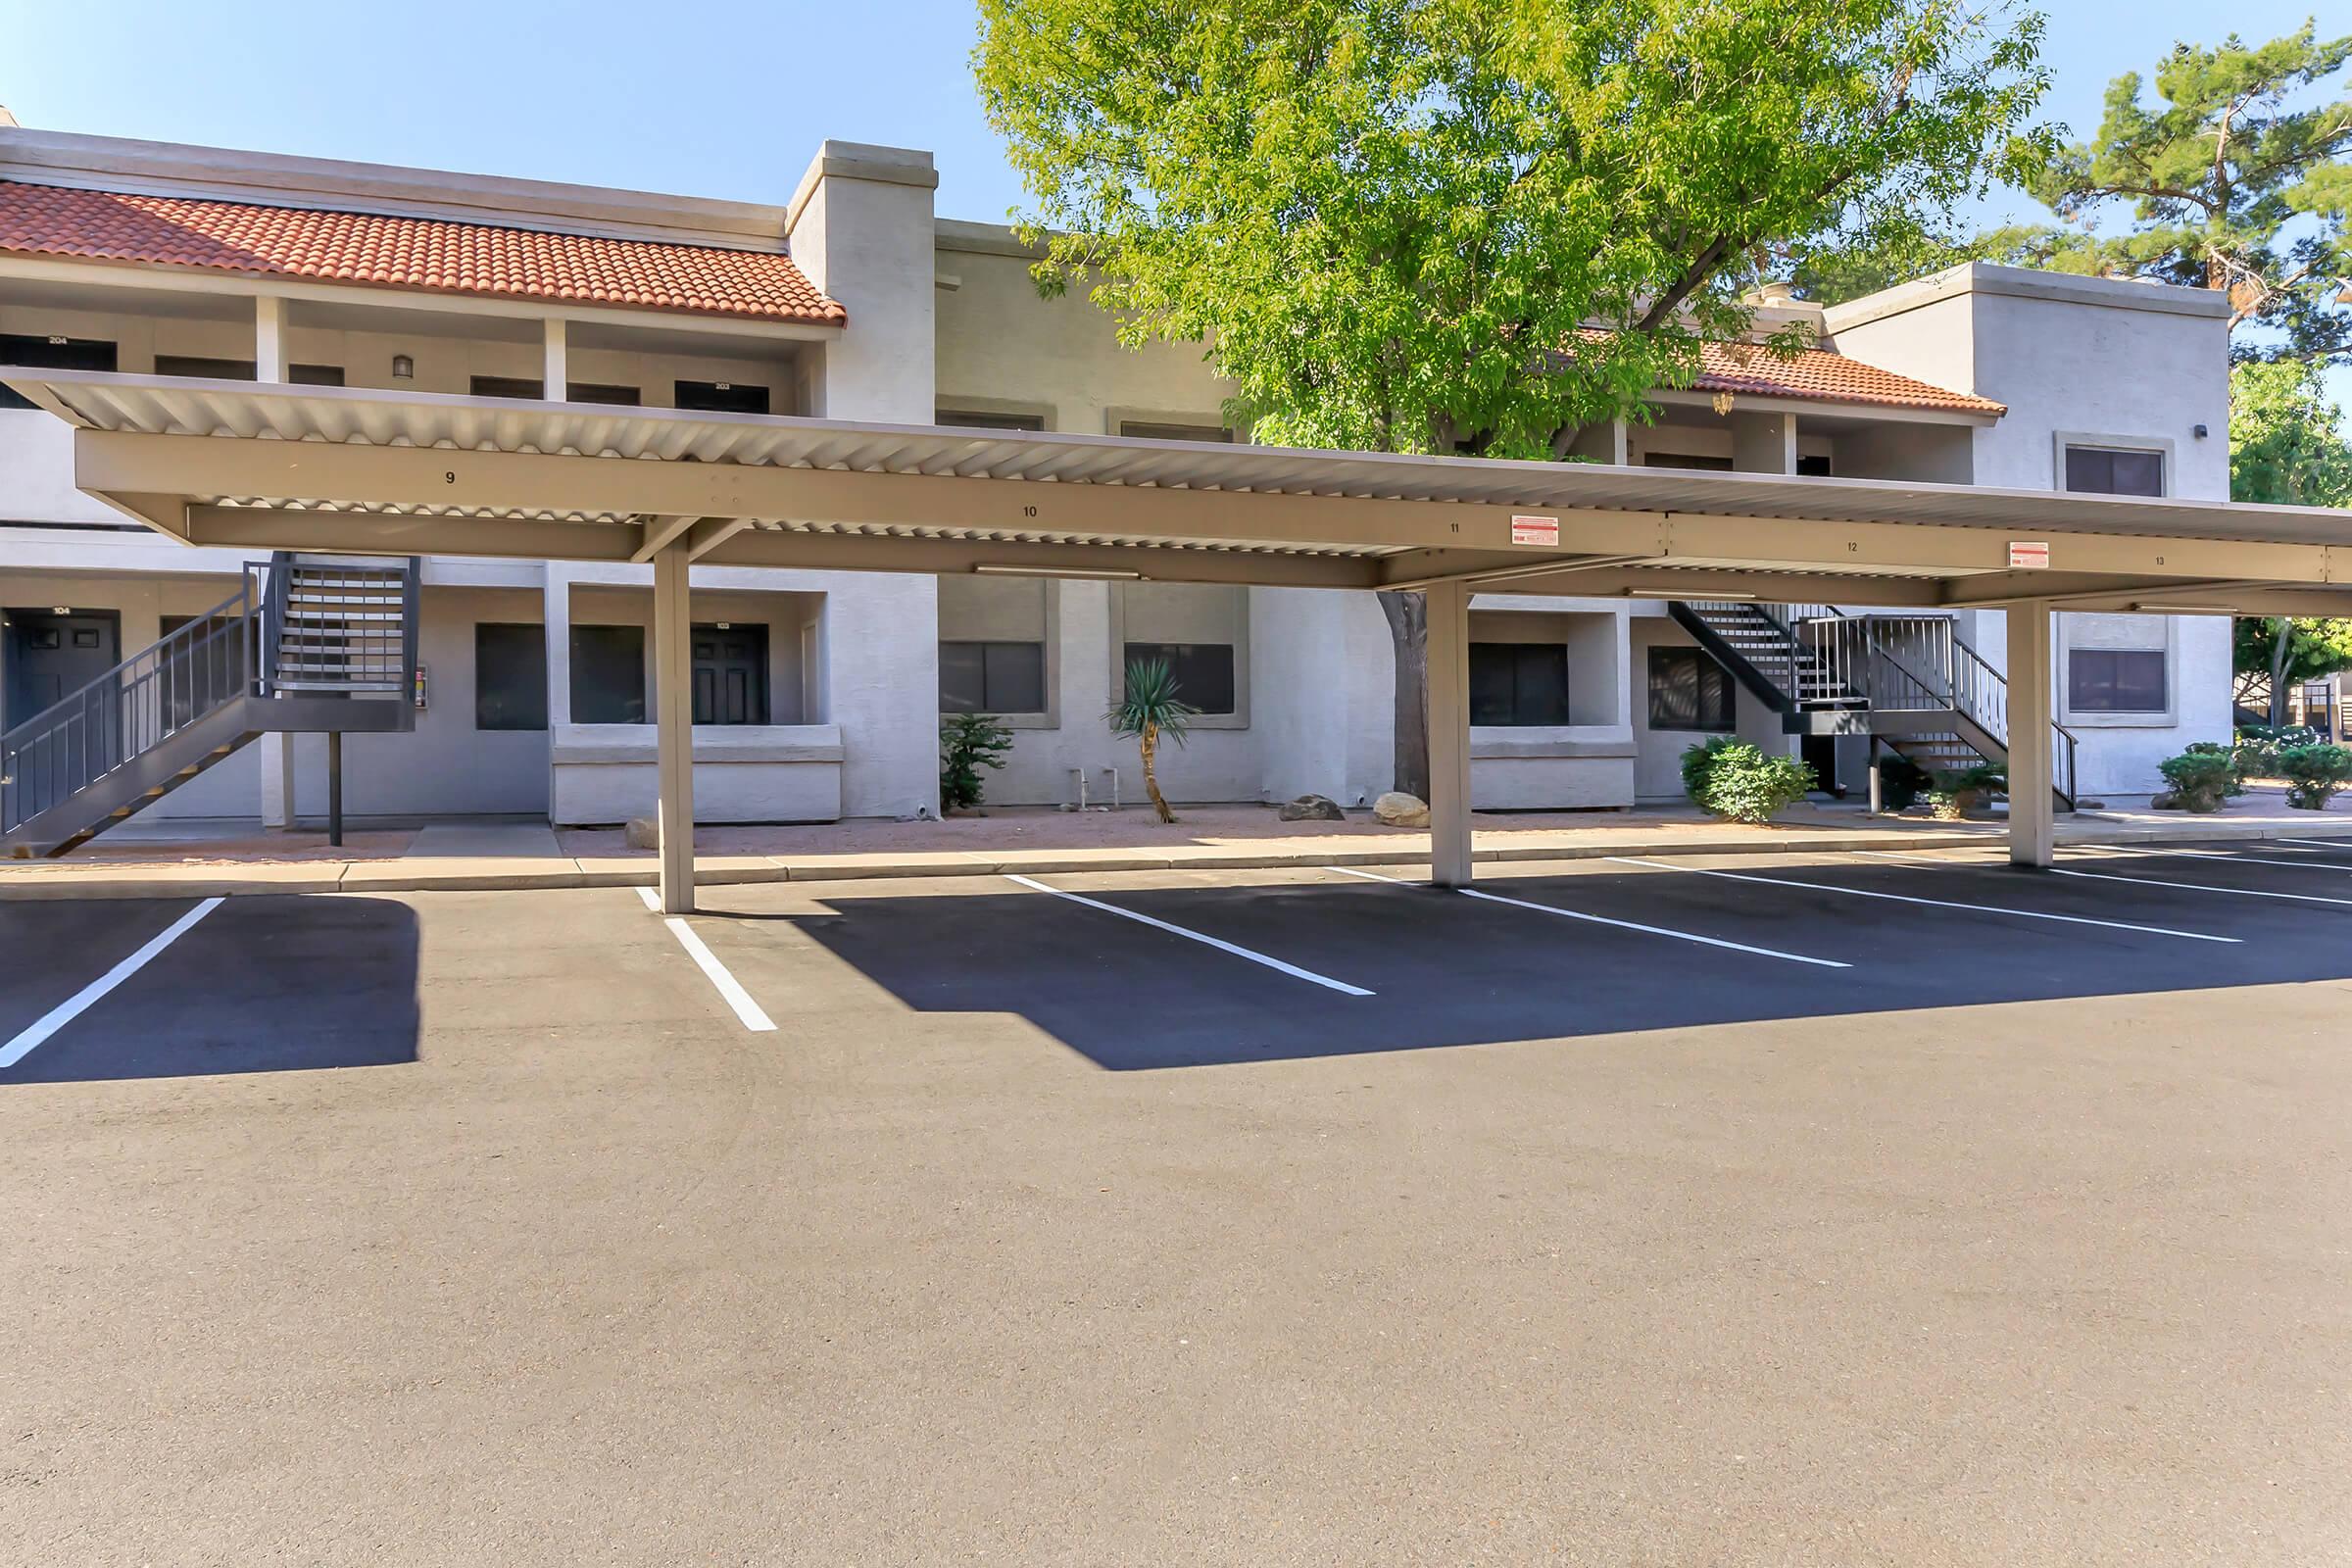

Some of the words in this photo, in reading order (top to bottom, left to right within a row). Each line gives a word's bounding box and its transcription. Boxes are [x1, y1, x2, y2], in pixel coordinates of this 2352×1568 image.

[49, 336, 68, 345] 204
[446, 471, 456, 484] 9
[1023, 506, 1037, 517] 10
[1450, 523, 1459, 533] 11
[1848, 542, 1858, 552] 12
[2156, 557, 2165, 565] 13
